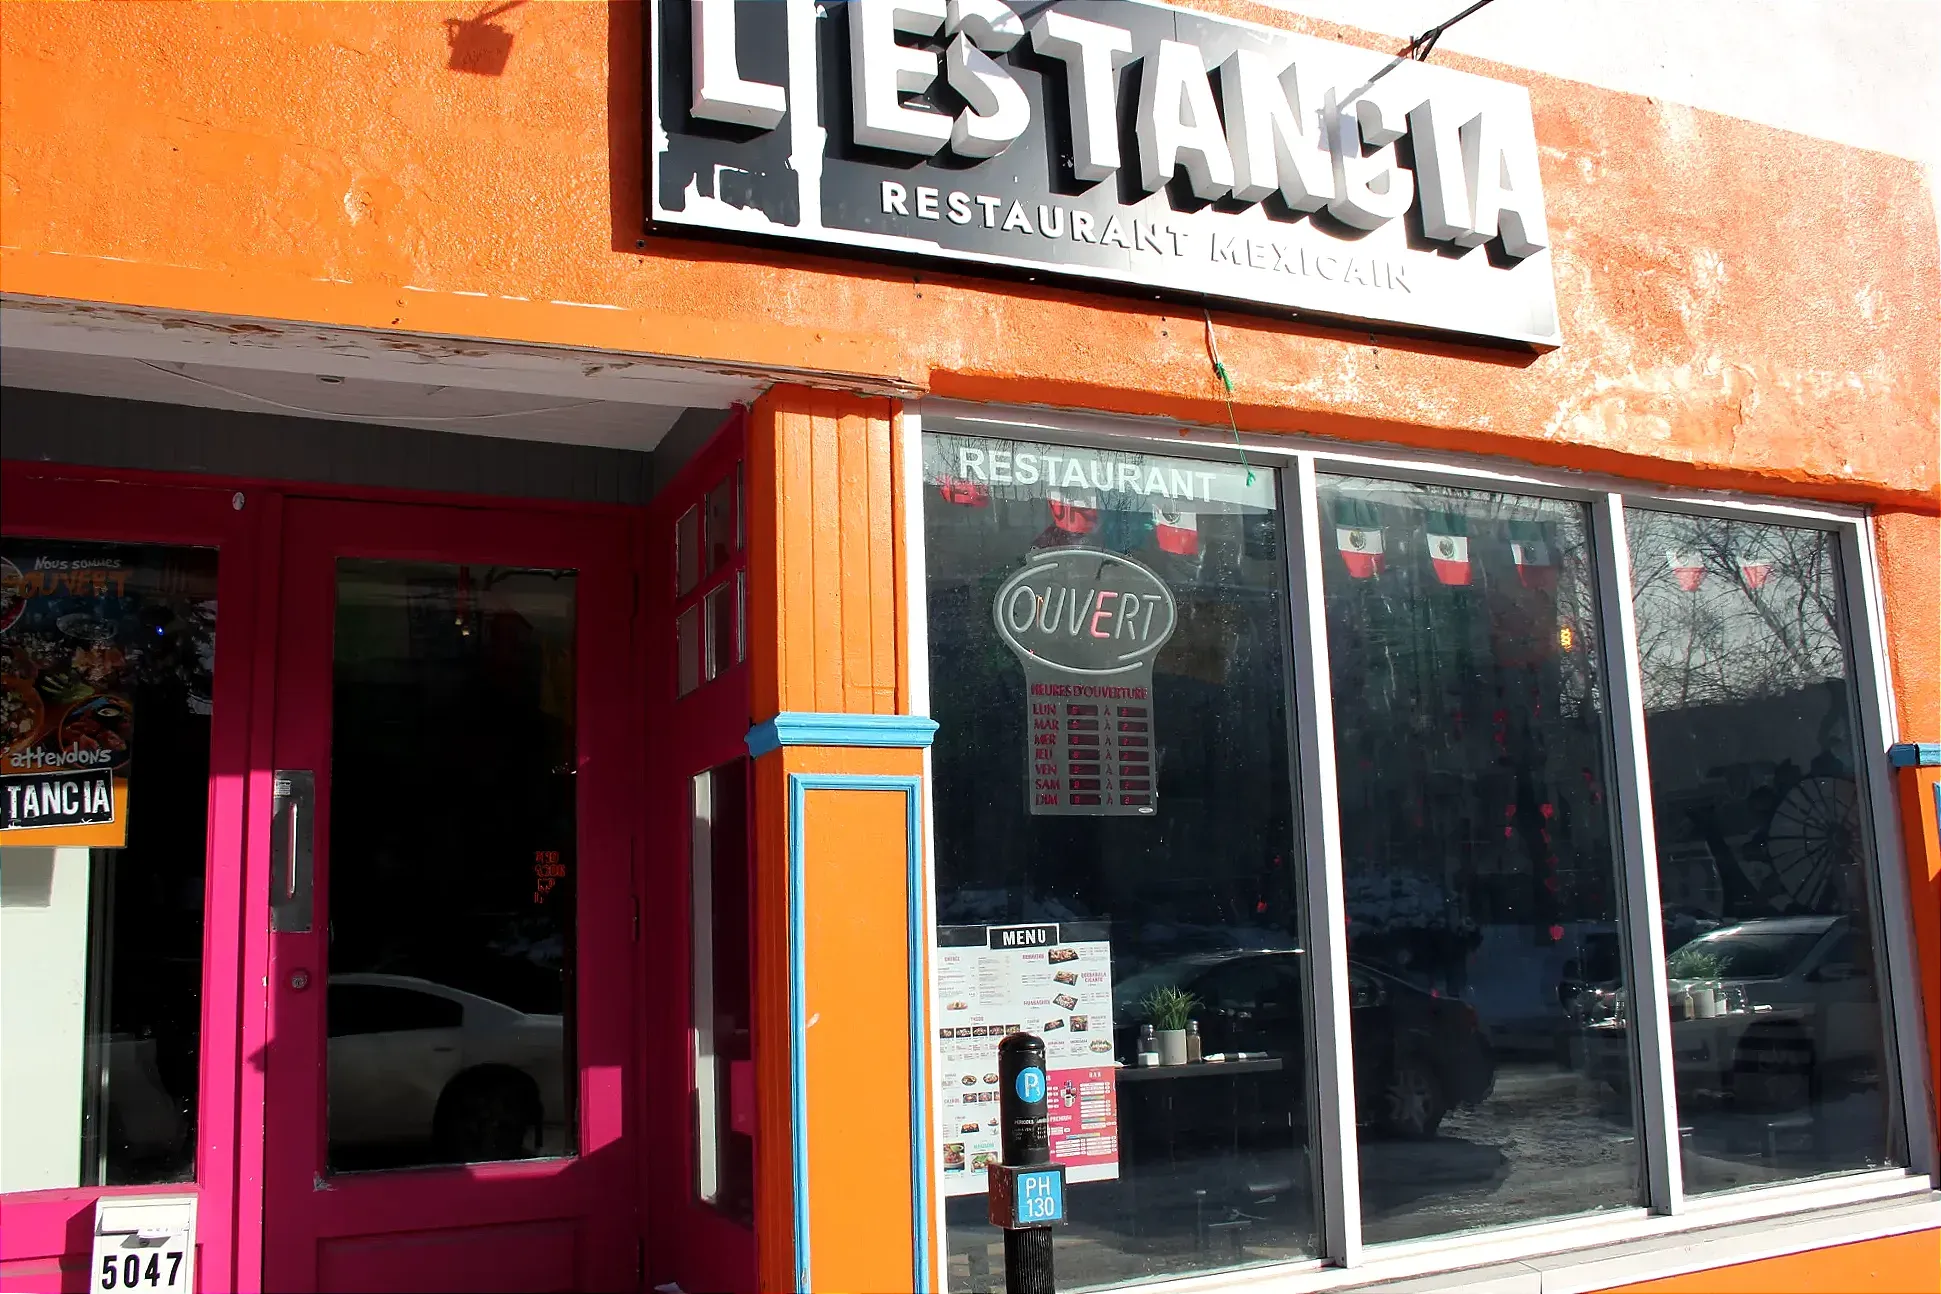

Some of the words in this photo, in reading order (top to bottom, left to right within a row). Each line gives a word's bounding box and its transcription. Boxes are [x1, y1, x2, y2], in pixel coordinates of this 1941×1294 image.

[880, 180, 1188, 258] RESTAURANT
[1210, 231, 1412, 294] MEXICAIN
[958, 446, 1217, 503] RESTAURANT
[1007, 585, 1161, 641] OUVERT
[1031, 683, 1072, 697] HEURES
[1033, 704, 1057, 715] LUN
[1034, 719, 1059, 731] MAR
[1035, 749, 1052, 760] JEU
[1035, 764, 1057, 775] VEN
[1035, 779, 1060, 790] SAM
[0, 779, 110, 819] TANCIA
[1002, 928, 1046, 946] MENU
[1026, 1177, 1051, 1198] PH
[1026, 1197, 1054, 1218] 130
[101, 1251, 184, 1291] 5047
